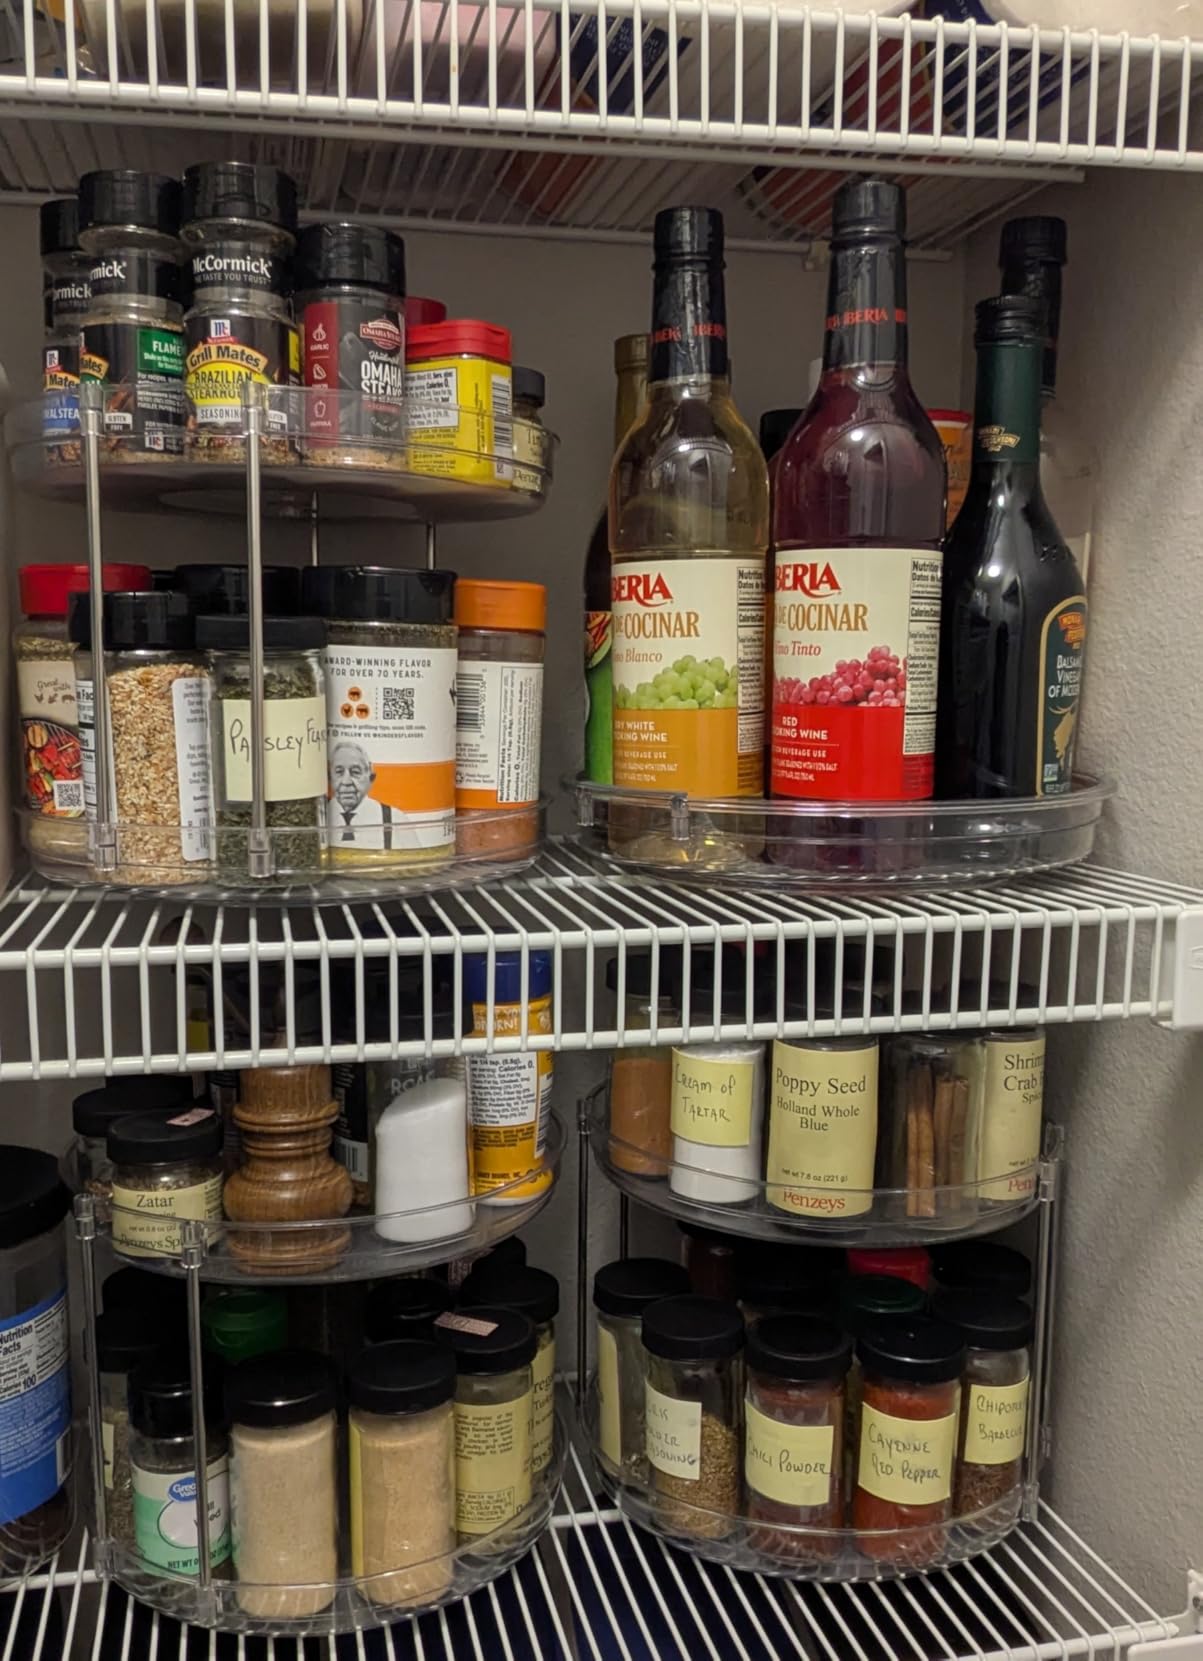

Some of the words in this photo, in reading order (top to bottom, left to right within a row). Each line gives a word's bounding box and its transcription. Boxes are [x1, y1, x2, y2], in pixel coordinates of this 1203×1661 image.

[190, 345, 212, 368] Grill
[216, 345, 261, 368] Mates
[194, 370, 253, 385] BRAZILIAN
[788, 603, 868, 631] COCINAR
[624, 611, 700, 639] COCINAR
[625, 648, 663, 663] Blanco
[791, 640, 822, 656] Tinto
[324, 656, 396, 667] AWARD-WINNING
[399, 659, 432, 668] FLAVOR
[330, 667, 347, 677] FOR
[349, 668, 374, 677] OVER
[377, 669, 389, 679] 70
[392, 669, 425, 679] YEARS.
[1048, 684, 1061, 699] OF
[626, 721, 656, 731] WHITE
[782, 716, 798, 727] RED
[640, 732, 668, 742] WINE
[799, 729, 828, 740] WINE
[812, 750, 827, 758] USE
[498, 1064, 526, 1072] Calories
[776, 1067, 821, 1097] Poppy
[827, 1074, 866, 1095] Seed
[1004, 1073, 1038, 1091] Crab
[777, 1096, 817, 1117] Holland
[821, 1104, 860, 1118] Whole
[800, 1116, 829, 1131] Blue
[136, 1194, 176, 1208] Zatar
[783, 1186, 846, 1213] Penzeys
[22, 1374, 37, 1390] 100
[868, 1422, 932, 1459] CAYENNE
[779, 1449, 831, 1474] POWDER
[902, 1459, 941, 1484] PEPPER
[167, 1561, 180, 1569] NET
[181, 1559, 193, 1568] WT
